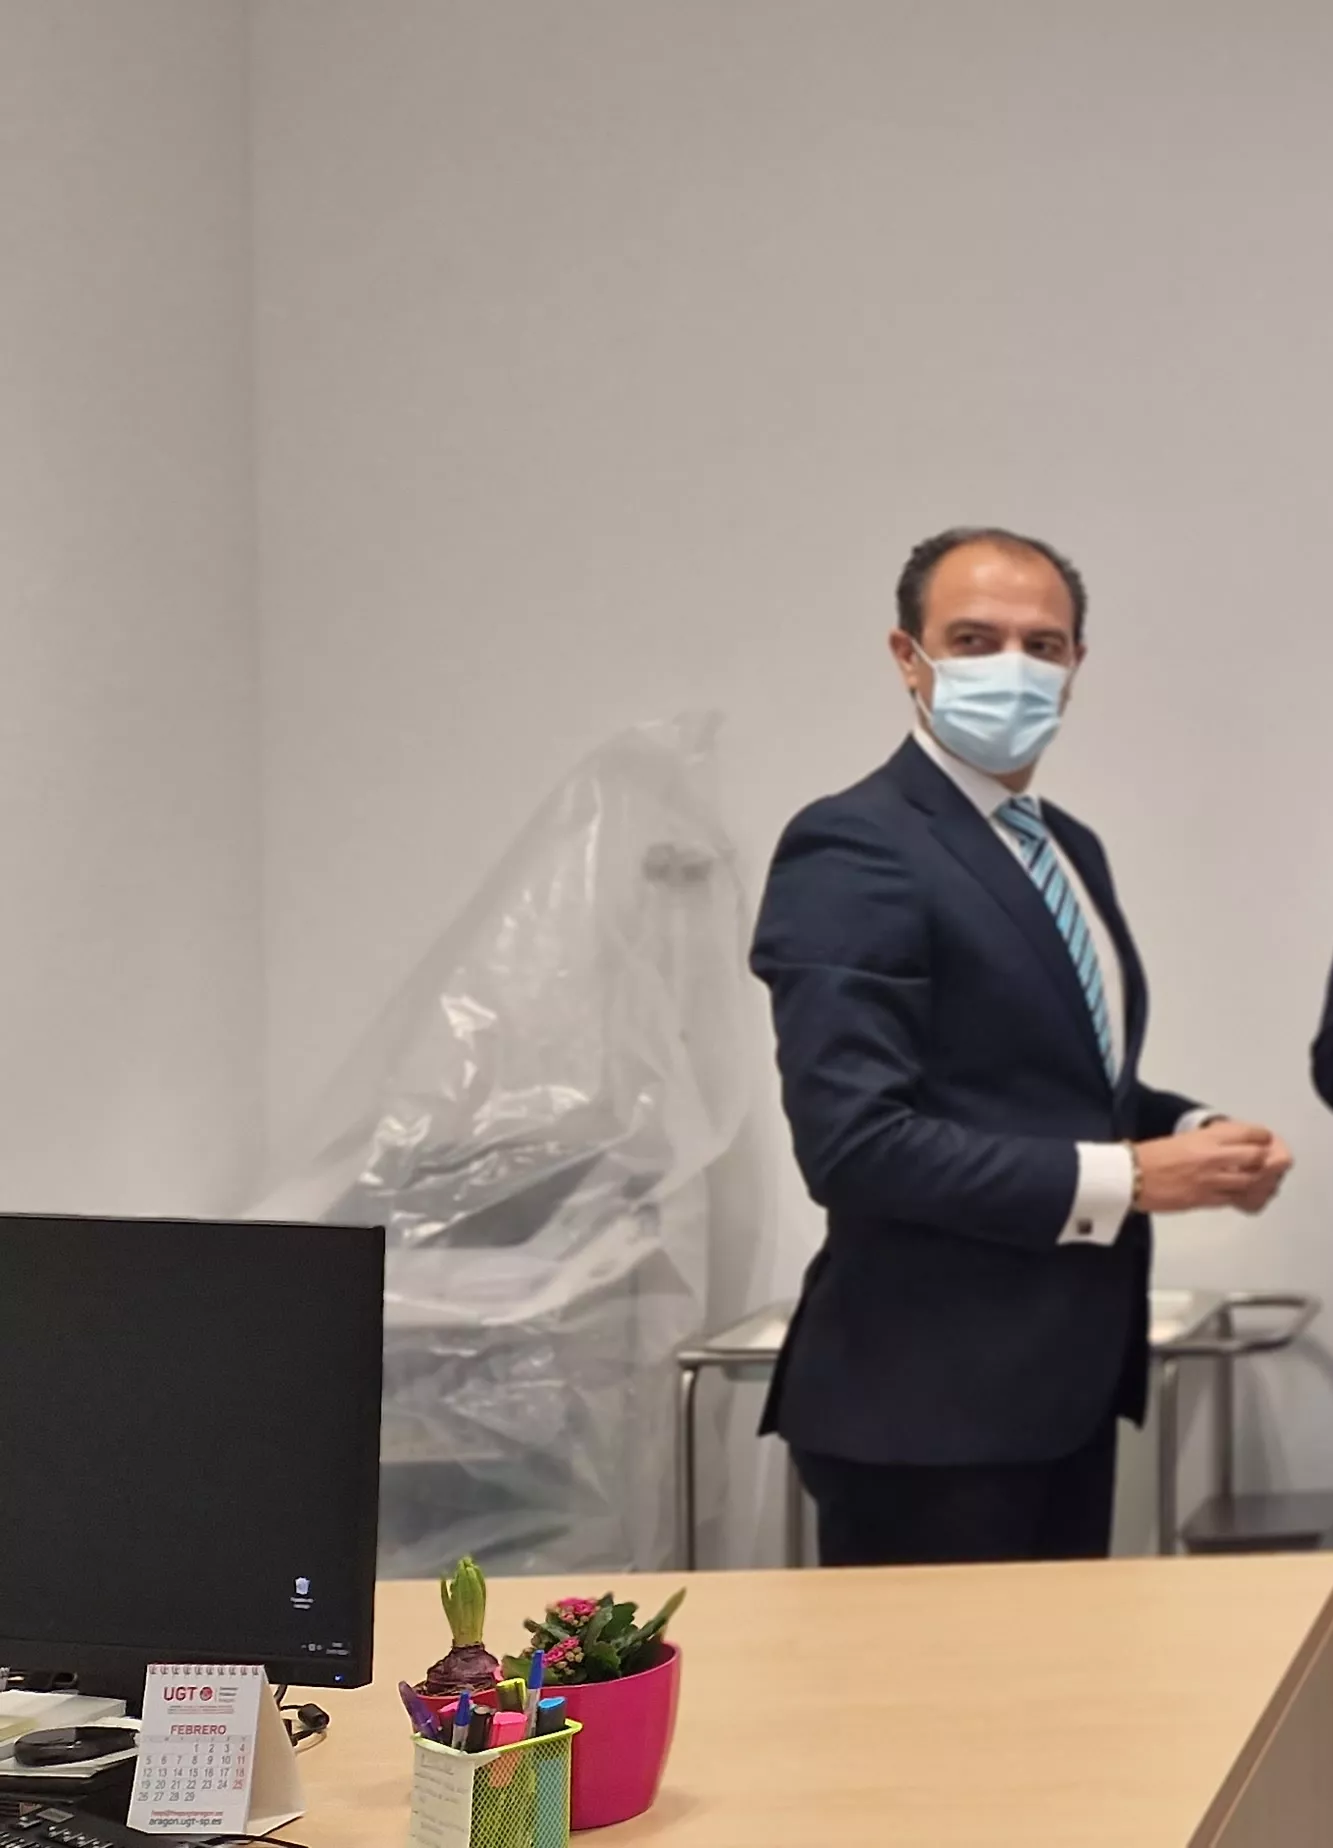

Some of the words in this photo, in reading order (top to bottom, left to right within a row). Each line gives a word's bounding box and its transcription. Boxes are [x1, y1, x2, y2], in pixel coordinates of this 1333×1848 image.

[164, 1686, 198, 1700] UGT
[170, 1725, 226, 1735] FEBRERO
[143, 1768, 152, 1778] 12
[158, 1768, 167, 1778] 13
[174, 1768, 182, 1778] 14
[189, 1768, 198, 1778] 15
[204, 1768, 214, 1778] 16
[220, 1768, 230, 1778] 17
[235, 1768, 244, 1778] 18
[141, 1780, 150, 1790] 19
[155, 1780, 166, 1790] 20
[170, 1780, 180, 1790] 21
[186, 1780, 196, 1790] 22
[202, 1780, 212, 1790] 23
[217, 1780, 227, 1790] 24
[232, 1780, 242, 1790] 25
[138, 1792, 149, 1801] 26
[153, 1792, 164, 1801] 27
[168, 1792, 180, 1801] 28
[184, 1792, 195, 1801] 29
